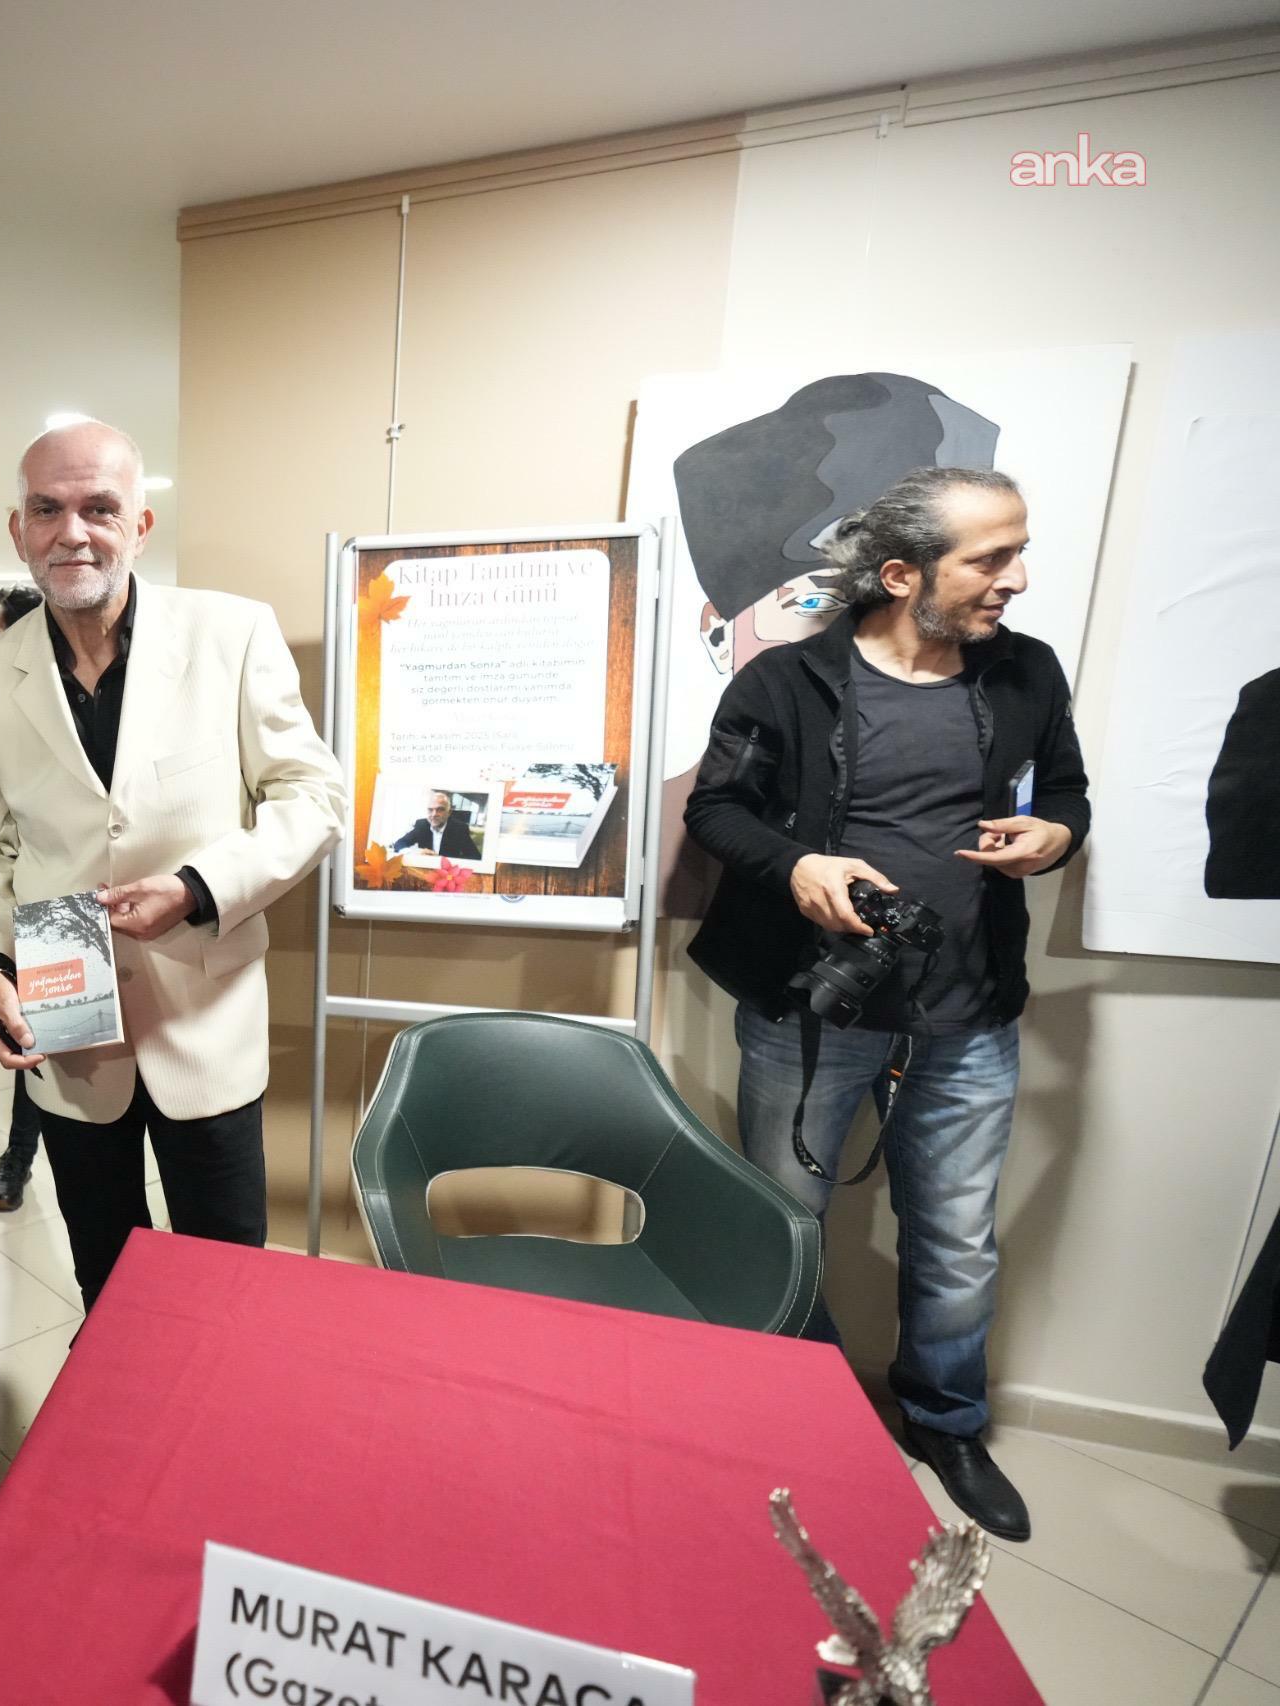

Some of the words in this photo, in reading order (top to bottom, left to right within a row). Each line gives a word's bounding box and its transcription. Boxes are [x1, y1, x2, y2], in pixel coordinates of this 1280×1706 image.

[399, 564, 458, 587] Kitap
[567, 561, 593, 577] ve
[230, 1587, 407, 1668] MURAT
[422, 1639, 645, 1706] KARAC
